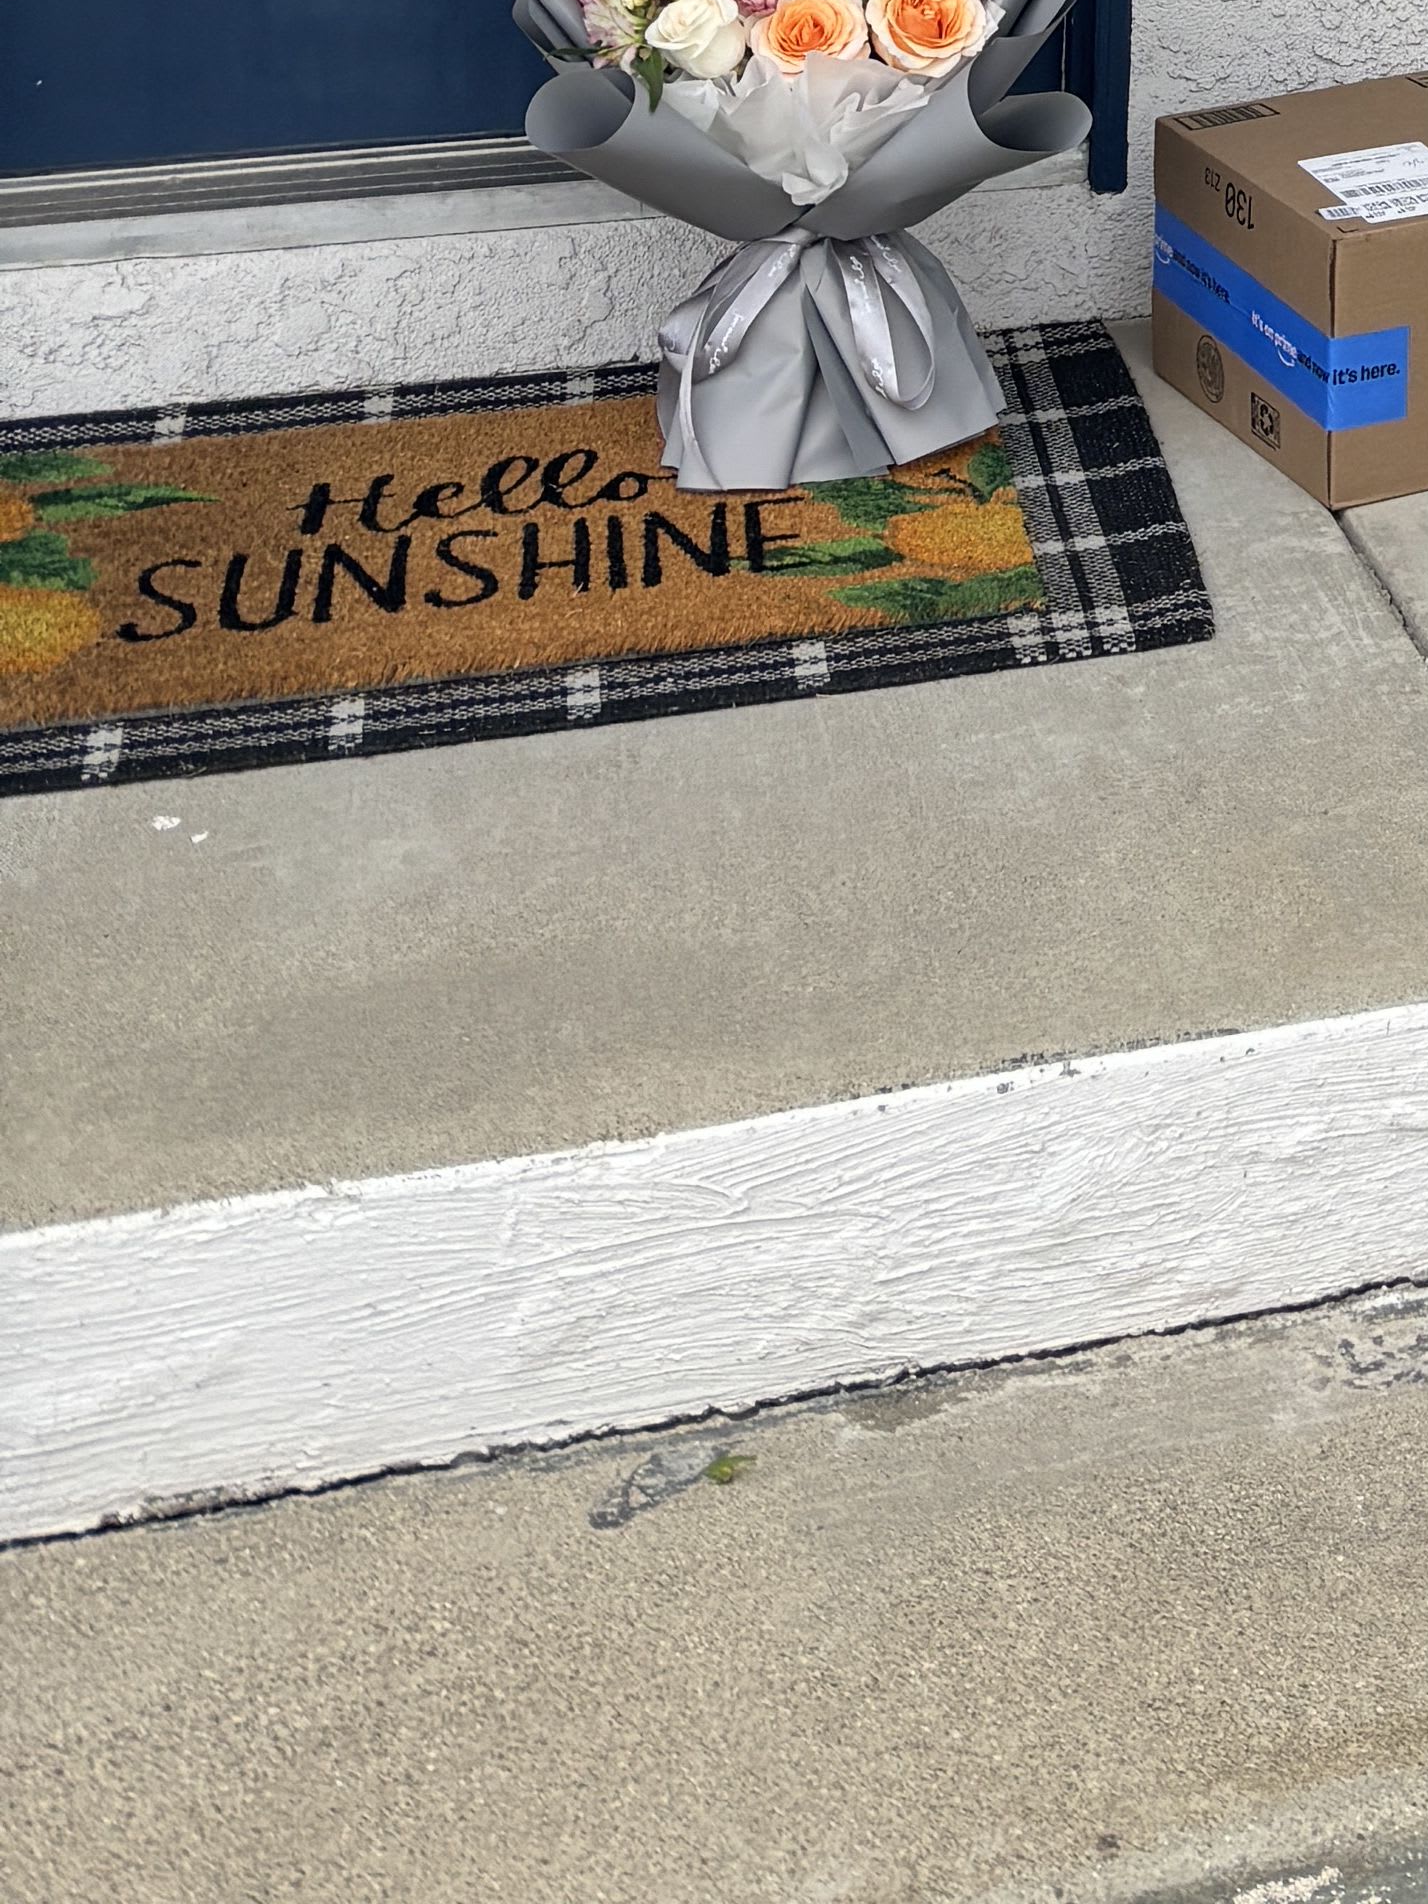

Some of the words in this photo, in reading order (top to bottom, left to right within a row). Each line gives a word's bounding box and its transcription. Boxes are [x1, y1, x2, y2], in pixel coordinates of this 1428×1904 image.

[1225, 182, 1254, 230] 130
[1360, 363, 1400, 381] here.
[288, 448, 679, 537] Hello
[116, 496, 808, 642] SUNSHINE
